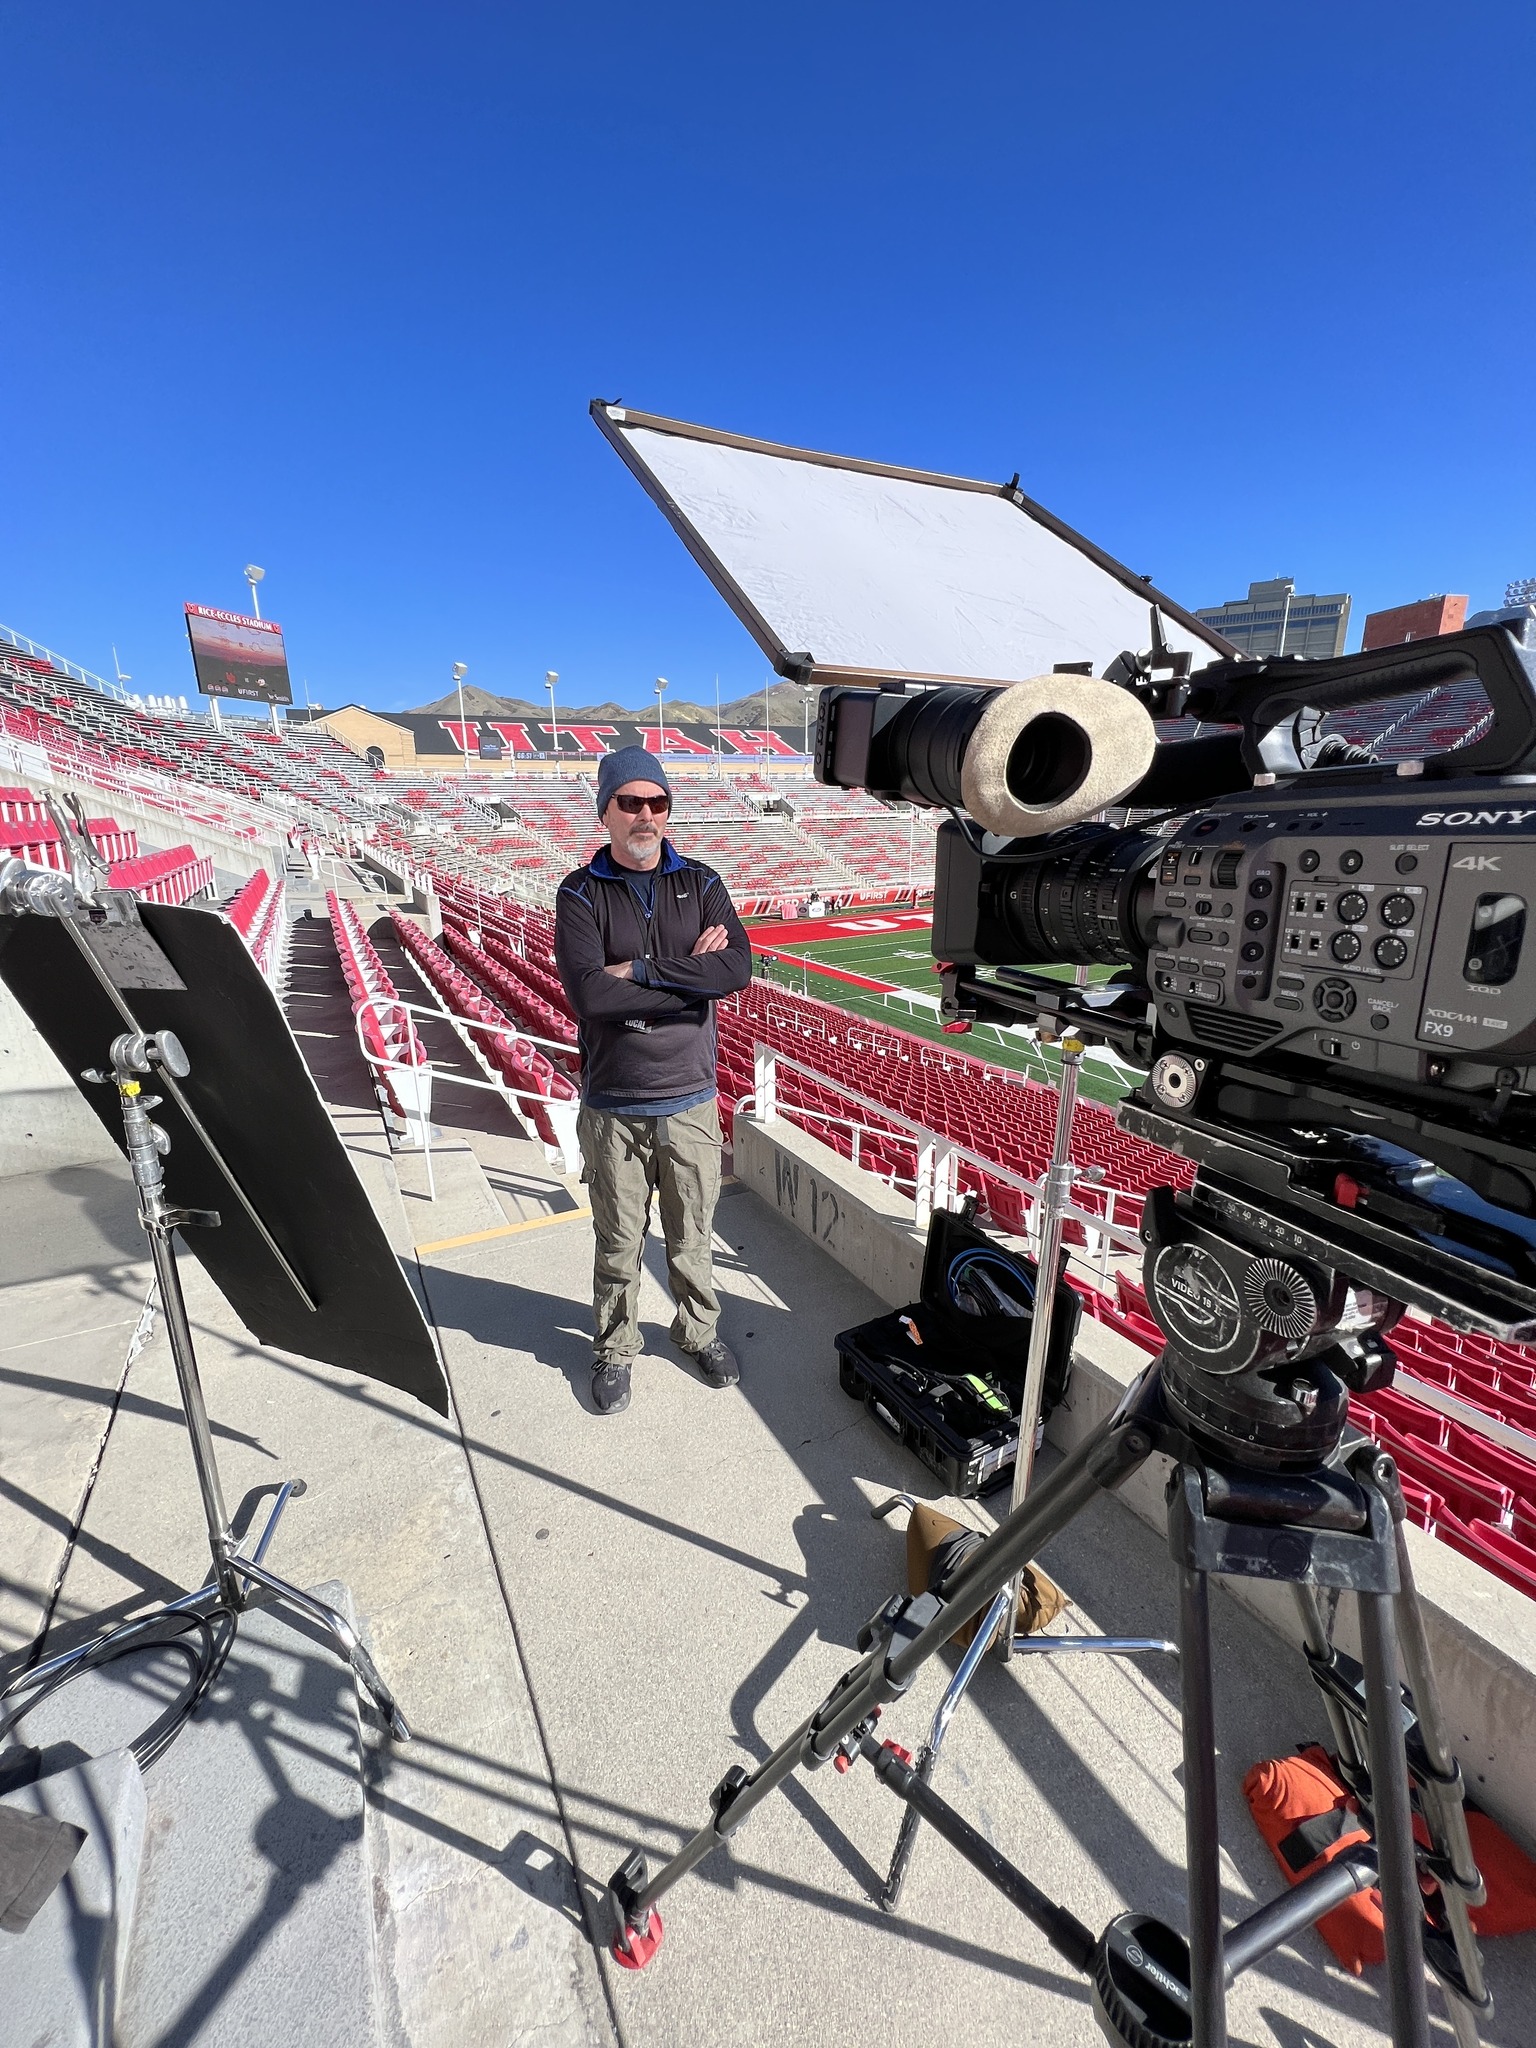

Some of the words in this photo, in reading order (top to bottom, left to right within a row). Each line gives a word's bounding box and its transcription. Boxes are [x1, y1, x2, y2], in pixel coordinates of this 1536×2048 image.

[198, 606, 241, 623] RICE-ECCLES
[242, 616, 272, 631] STADIUM
[438, 720, 813, 755] UTAH
[1415, 810, 1536, 826] SONY
[1347, 858, 1355, 866] 8
[1452, 856, 1502, 871] 4K
[860, 891, 888, 901] UFIRST
[1009, 891, 1017, 900] G
[1203, 959, 1226, 968] SHUTTER
[1362, 966, 1382, 975] LEVEL
[1281, 989, 1298, 997] MENU
[1466, 984, 1501, 995] XQD
[1372, 1004, 1391, 1013] BACK
[625, 1019, 646, 1030] LOCAL
[1424, 1020, 1454, 1037] FX9
[774, 1147, 800, 1219] W
[809, 1177, 840, 1248] 12
[1227, 1202, 1236, 1212] 50
[1242, 1210, 1252, 1219] 40
[1258, 1217, 1268, 1227] 30
[1275, 1225, 1285, 1235] 20
[1293, 1234, 1303, 1244] 10
[1144, 1962, 1189, 2002] sachtler
